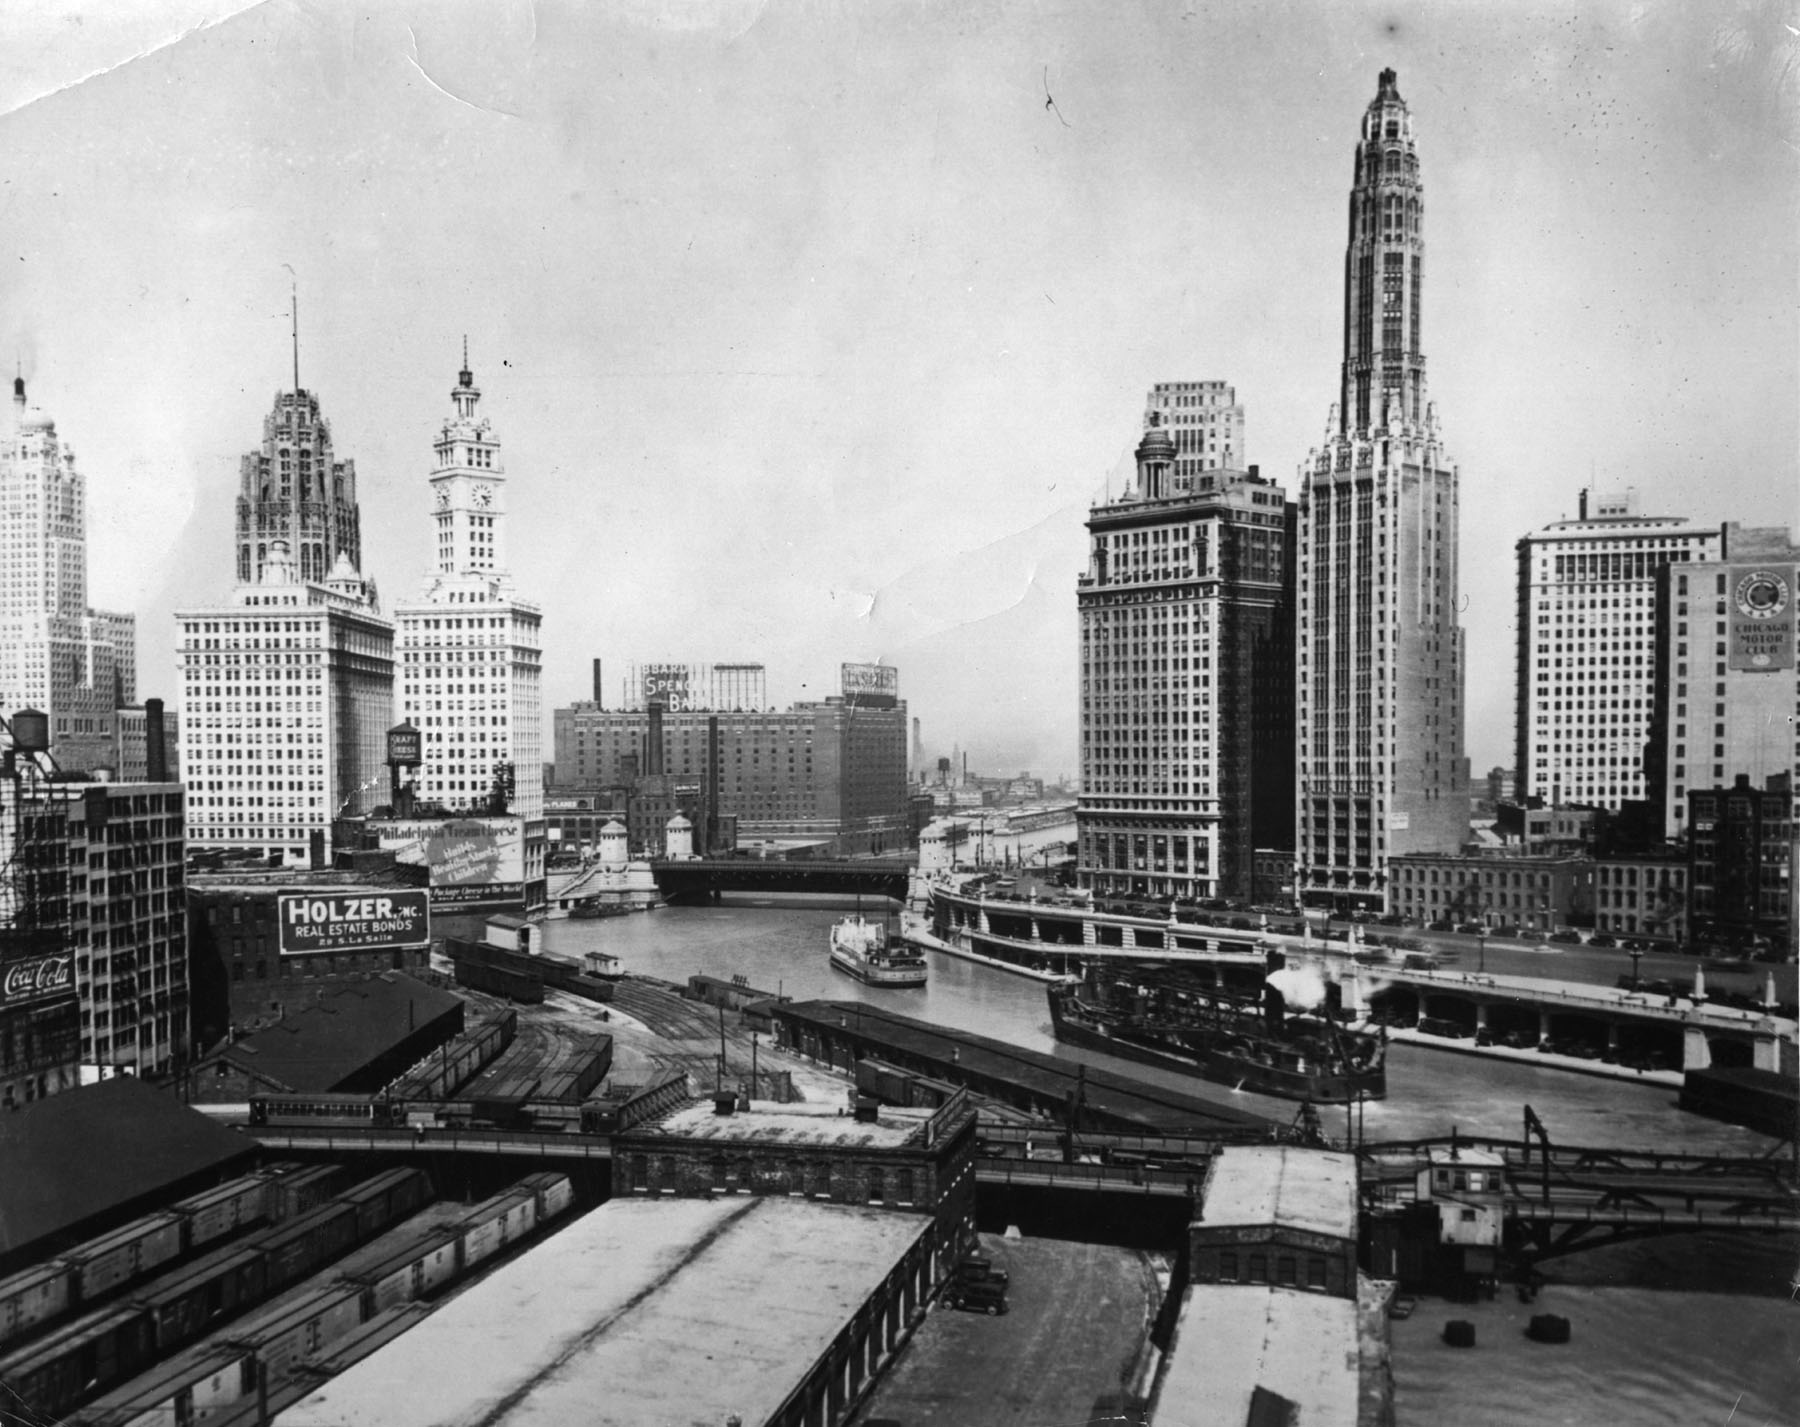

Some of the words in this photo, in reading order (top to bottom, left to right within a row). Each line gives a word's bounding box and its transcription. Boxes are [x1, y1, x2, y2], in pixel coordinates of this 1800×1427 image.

[1735, 624, 1789, 632] CHICAGO
[1740, 634, 1783, 643] MOTOR
[1745, 645, 1778, 654] CLUB
[295, 925, 325, 937] REAL
[329, 922, 368, 936] ESTATE
[372, 920, 413, 933] BONDS
[365, 934, 393, 943] Salle
